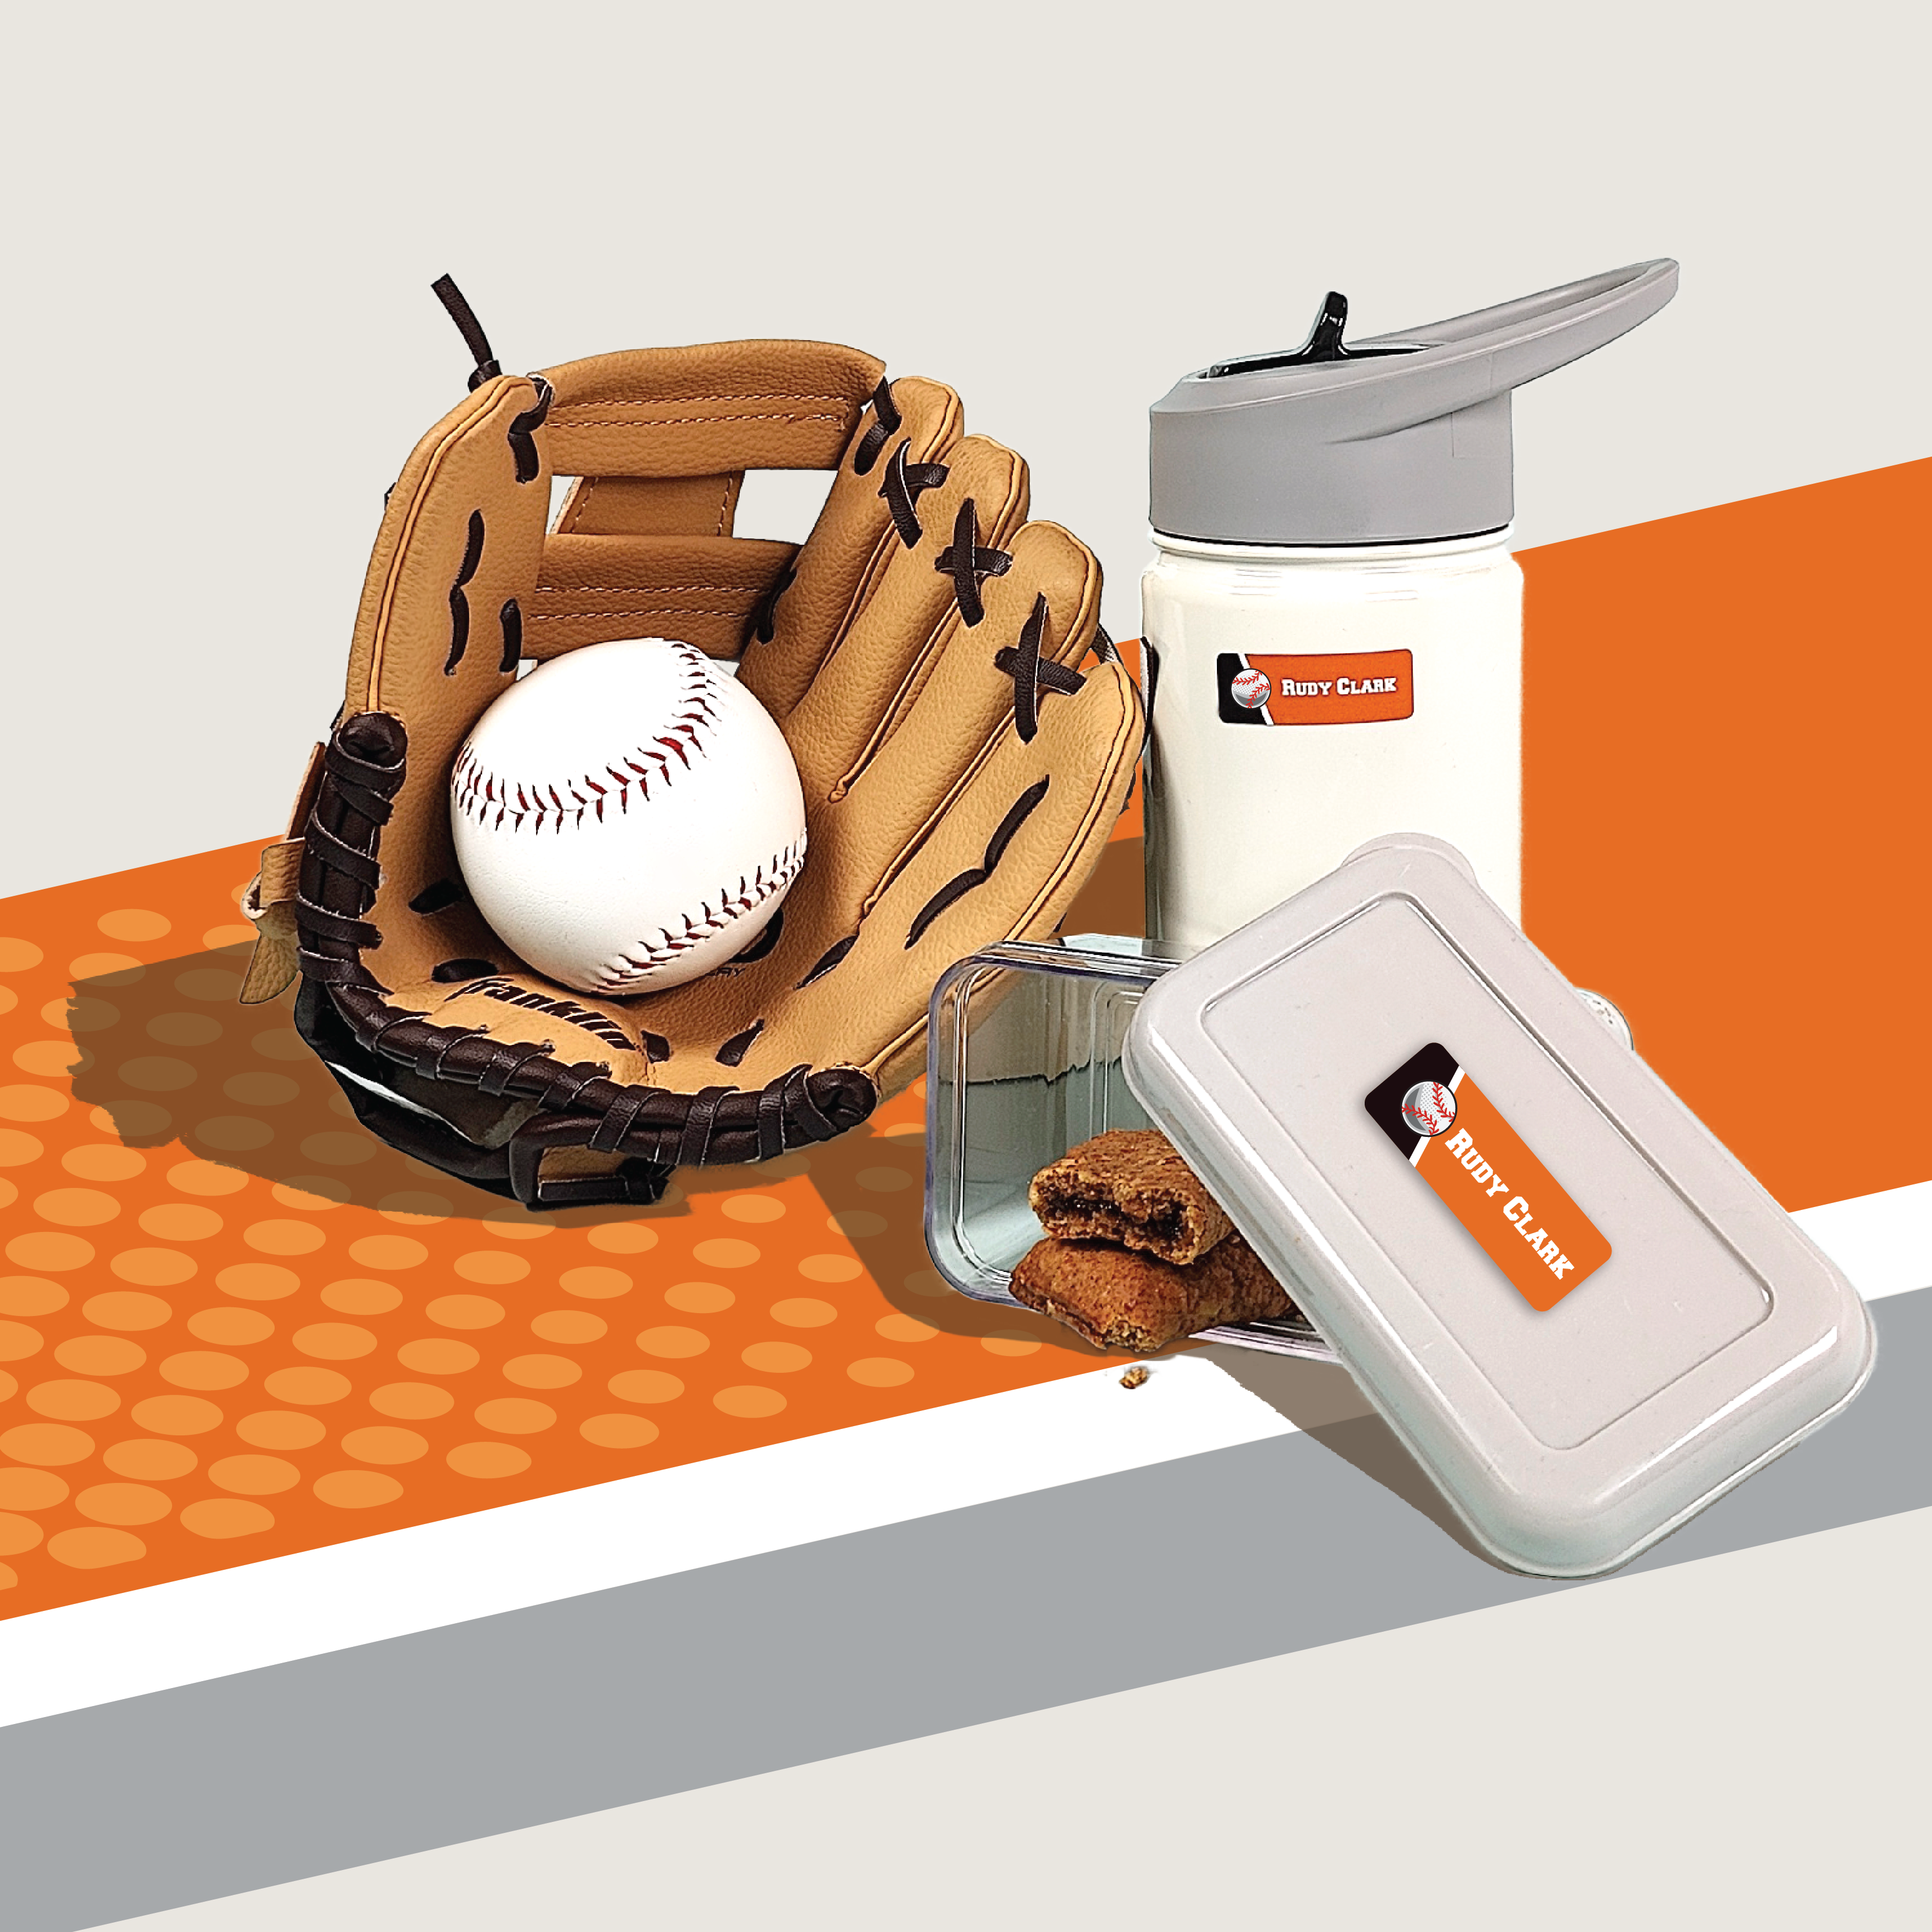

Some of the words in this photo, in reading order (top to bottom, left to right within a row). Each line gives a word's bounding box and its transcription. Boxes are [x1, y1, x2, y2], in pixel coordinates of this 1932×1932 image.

[1281, 679, 1332, 696] RUDY
[1336, 677, 1397, 695] CLARK
[1445, 1128, 1510, 1197] RUDY
[1503, 1196, 1574, 1280] CLARK
